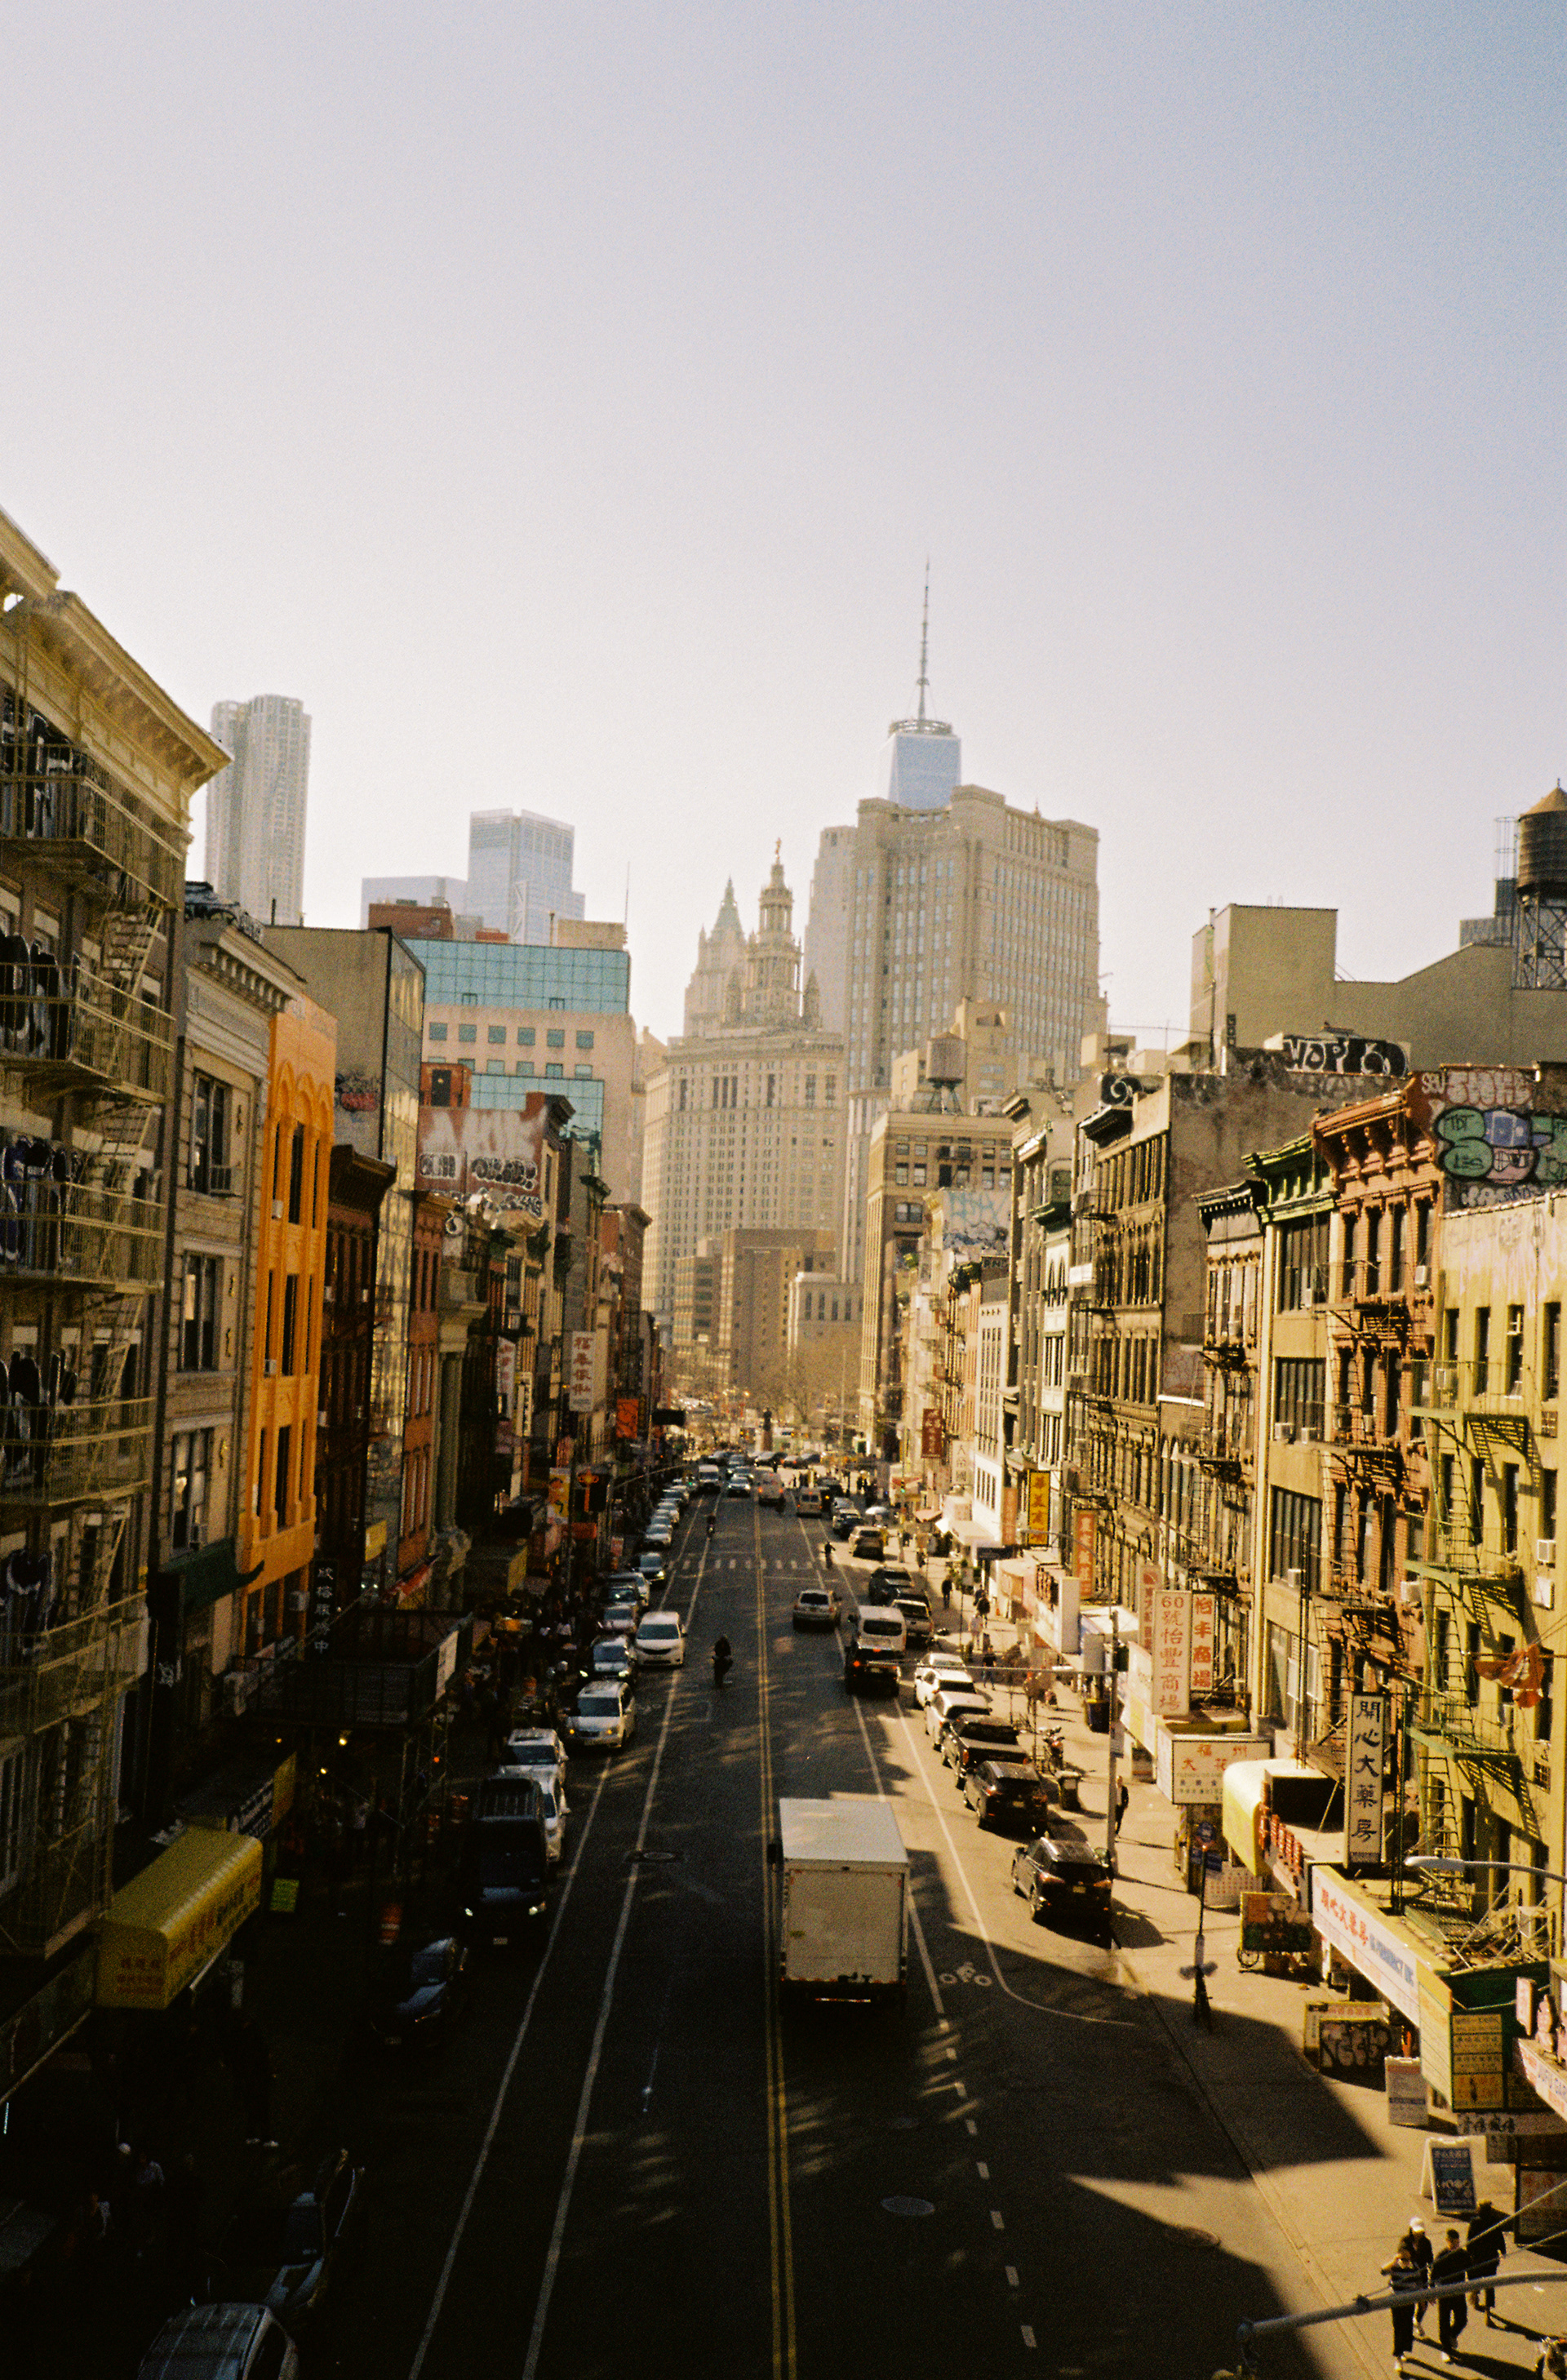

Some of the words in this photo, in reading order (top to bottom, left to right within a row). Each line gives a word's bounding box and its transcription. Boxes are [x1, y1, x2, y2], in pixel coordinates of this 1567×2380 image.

[1351, 1700, 1382, 1843] 開心大藥房
